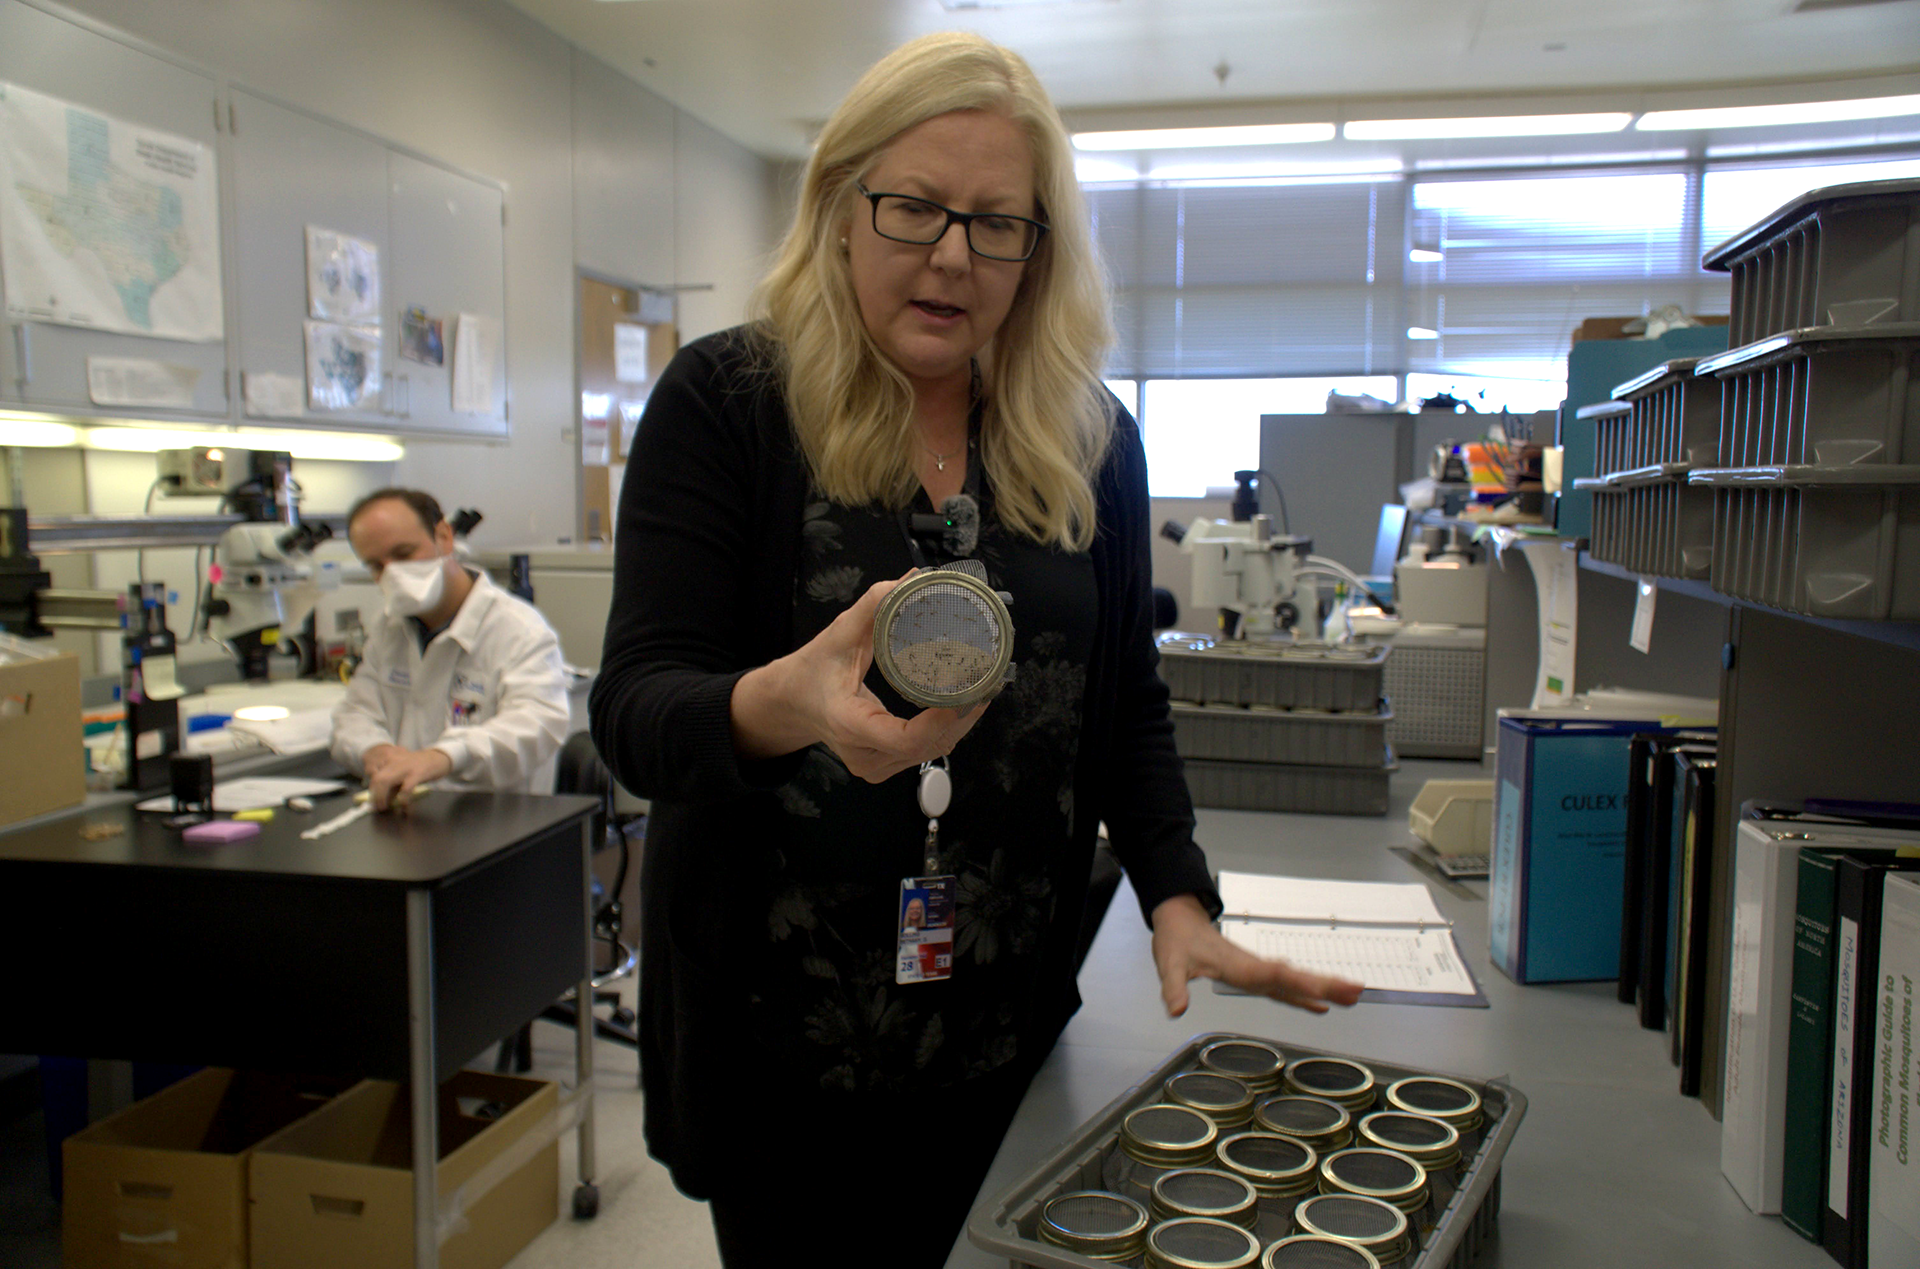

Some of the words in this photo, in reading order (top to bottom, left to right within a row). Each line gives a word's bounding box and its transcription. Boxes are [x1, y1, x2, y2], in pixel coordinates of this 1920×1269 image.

[1561, 795, 1617, 811] CULEX
[1796, 940, 1822, 957] AMERICA
[901, 961, 914, 973] 28
[935, 957, 948, 968] E1
[1884, 975, 1895, 993] to
[1901, 974, 1914, 996] of
[1882, 996, 1895, 1042] Guide
[1898, 998, 1914, 1092] Mosquitoes
[1878, 1043, 1893, 1148] Photographic
[1836, 1080, 1846, 1149] ARIZONA
[1896, 1093, 1910, 1166] Common
